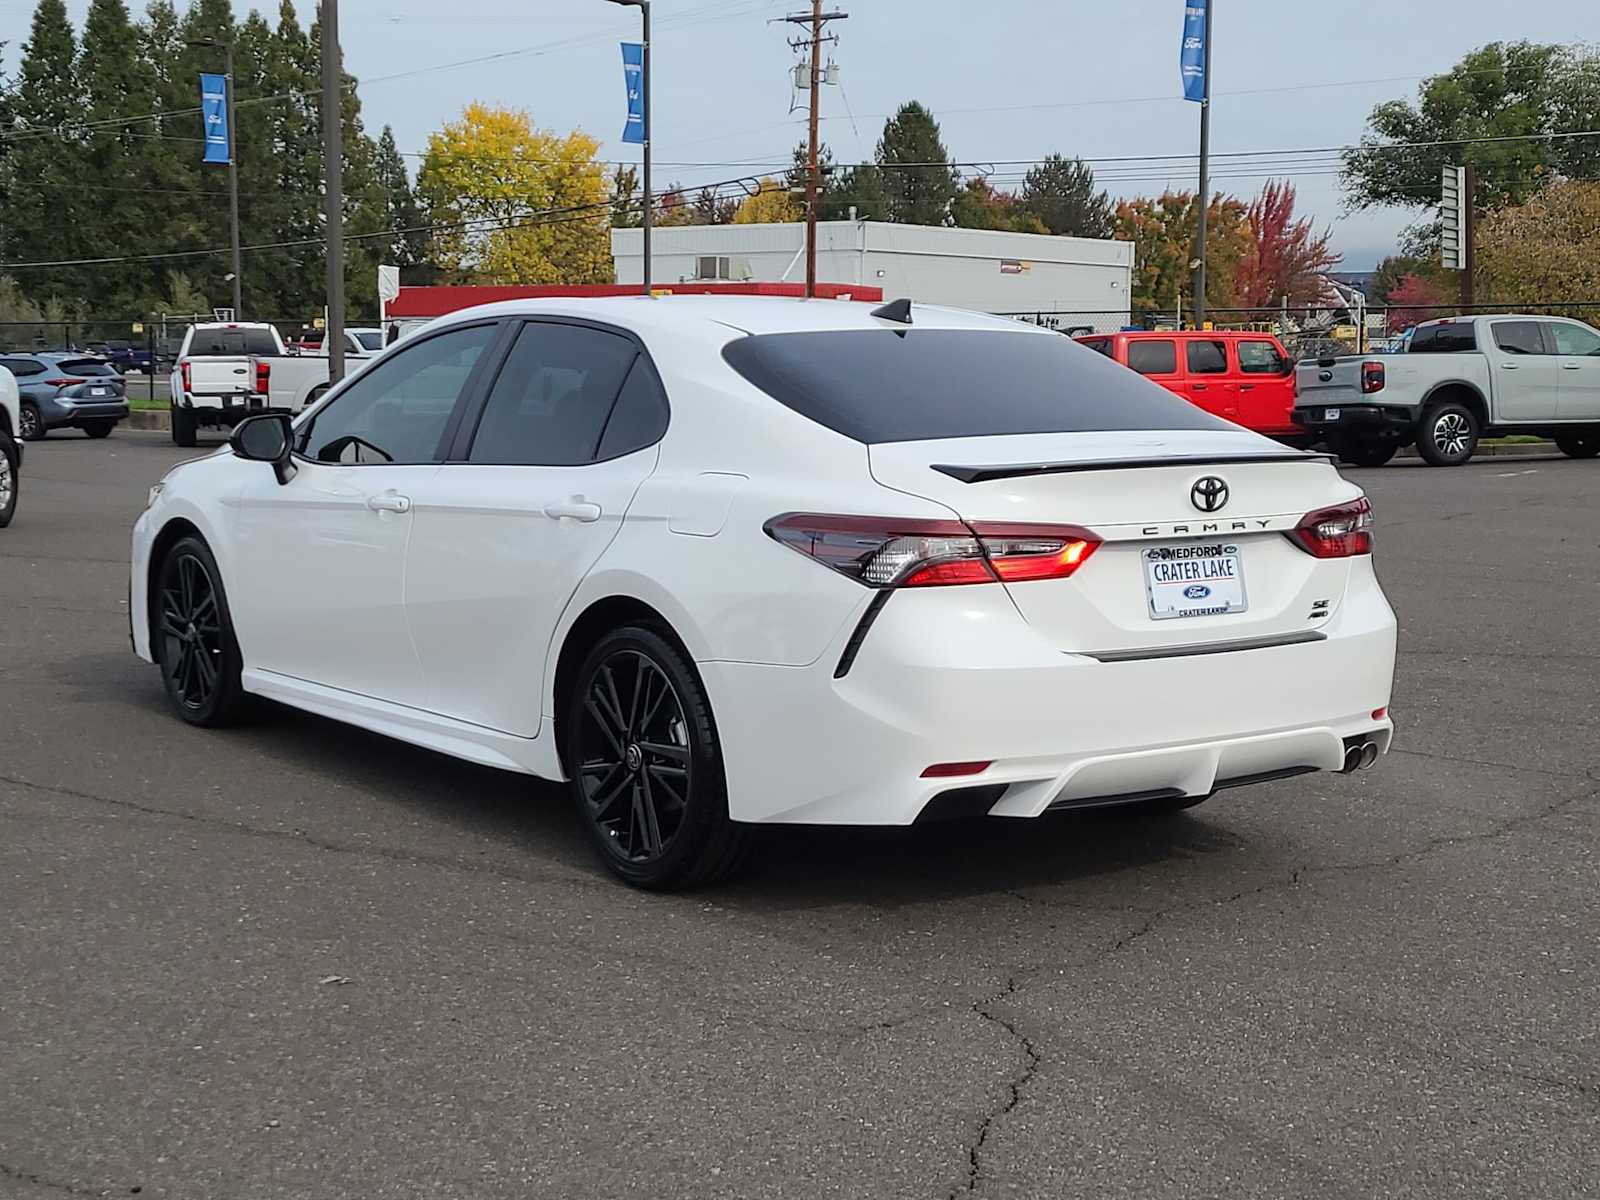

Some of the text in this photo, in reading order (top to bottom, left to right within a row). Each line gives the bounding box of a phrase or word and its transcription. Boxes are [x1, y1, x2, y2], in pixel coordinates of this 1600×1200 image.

[1143, 520, 1270, 535] CAMRY
[1170, 546, 1218, 559] MEDFORD
[1154, 559, 1234, 582] CRATER LAKE
[1312, 600, 1329, 609] SE
